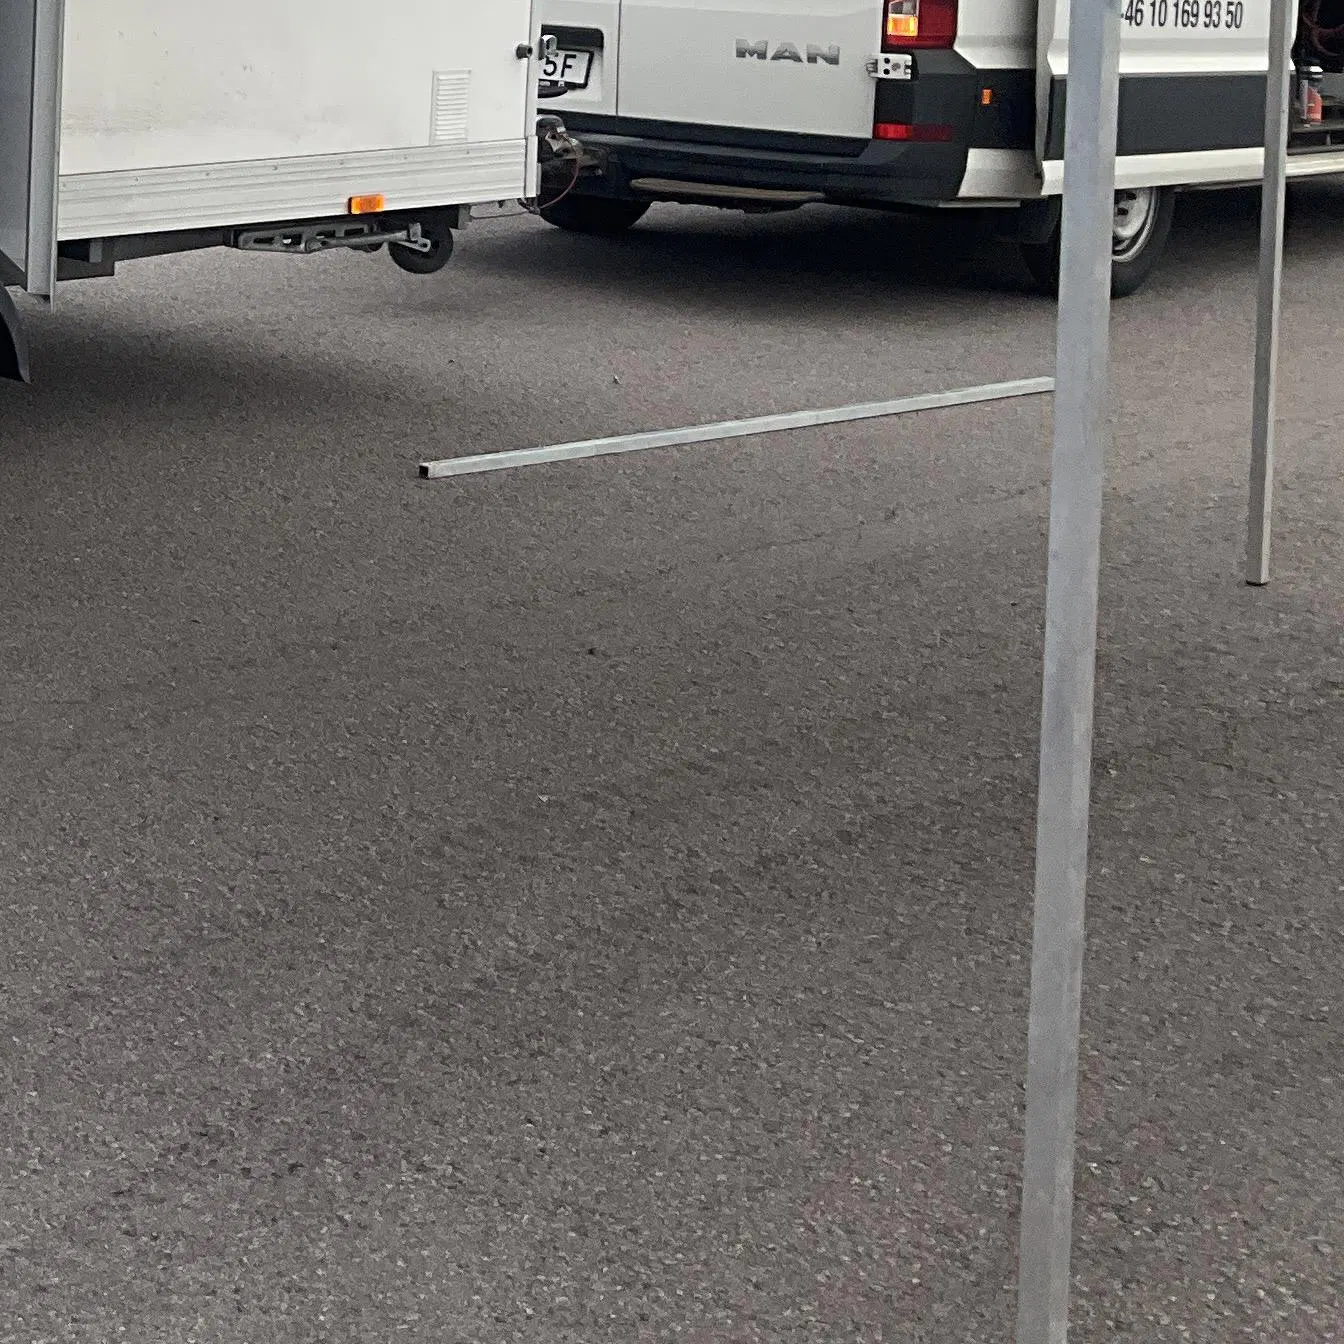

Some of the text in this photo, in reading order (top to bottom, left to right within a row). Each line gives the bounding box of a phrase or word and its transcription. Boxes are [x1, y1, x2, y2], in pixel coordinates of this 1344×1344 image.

[1203, 0, 1222, 29] 93
[1225, 0, 1244, 29] 50
[736, 38, 840, 65] MAN
